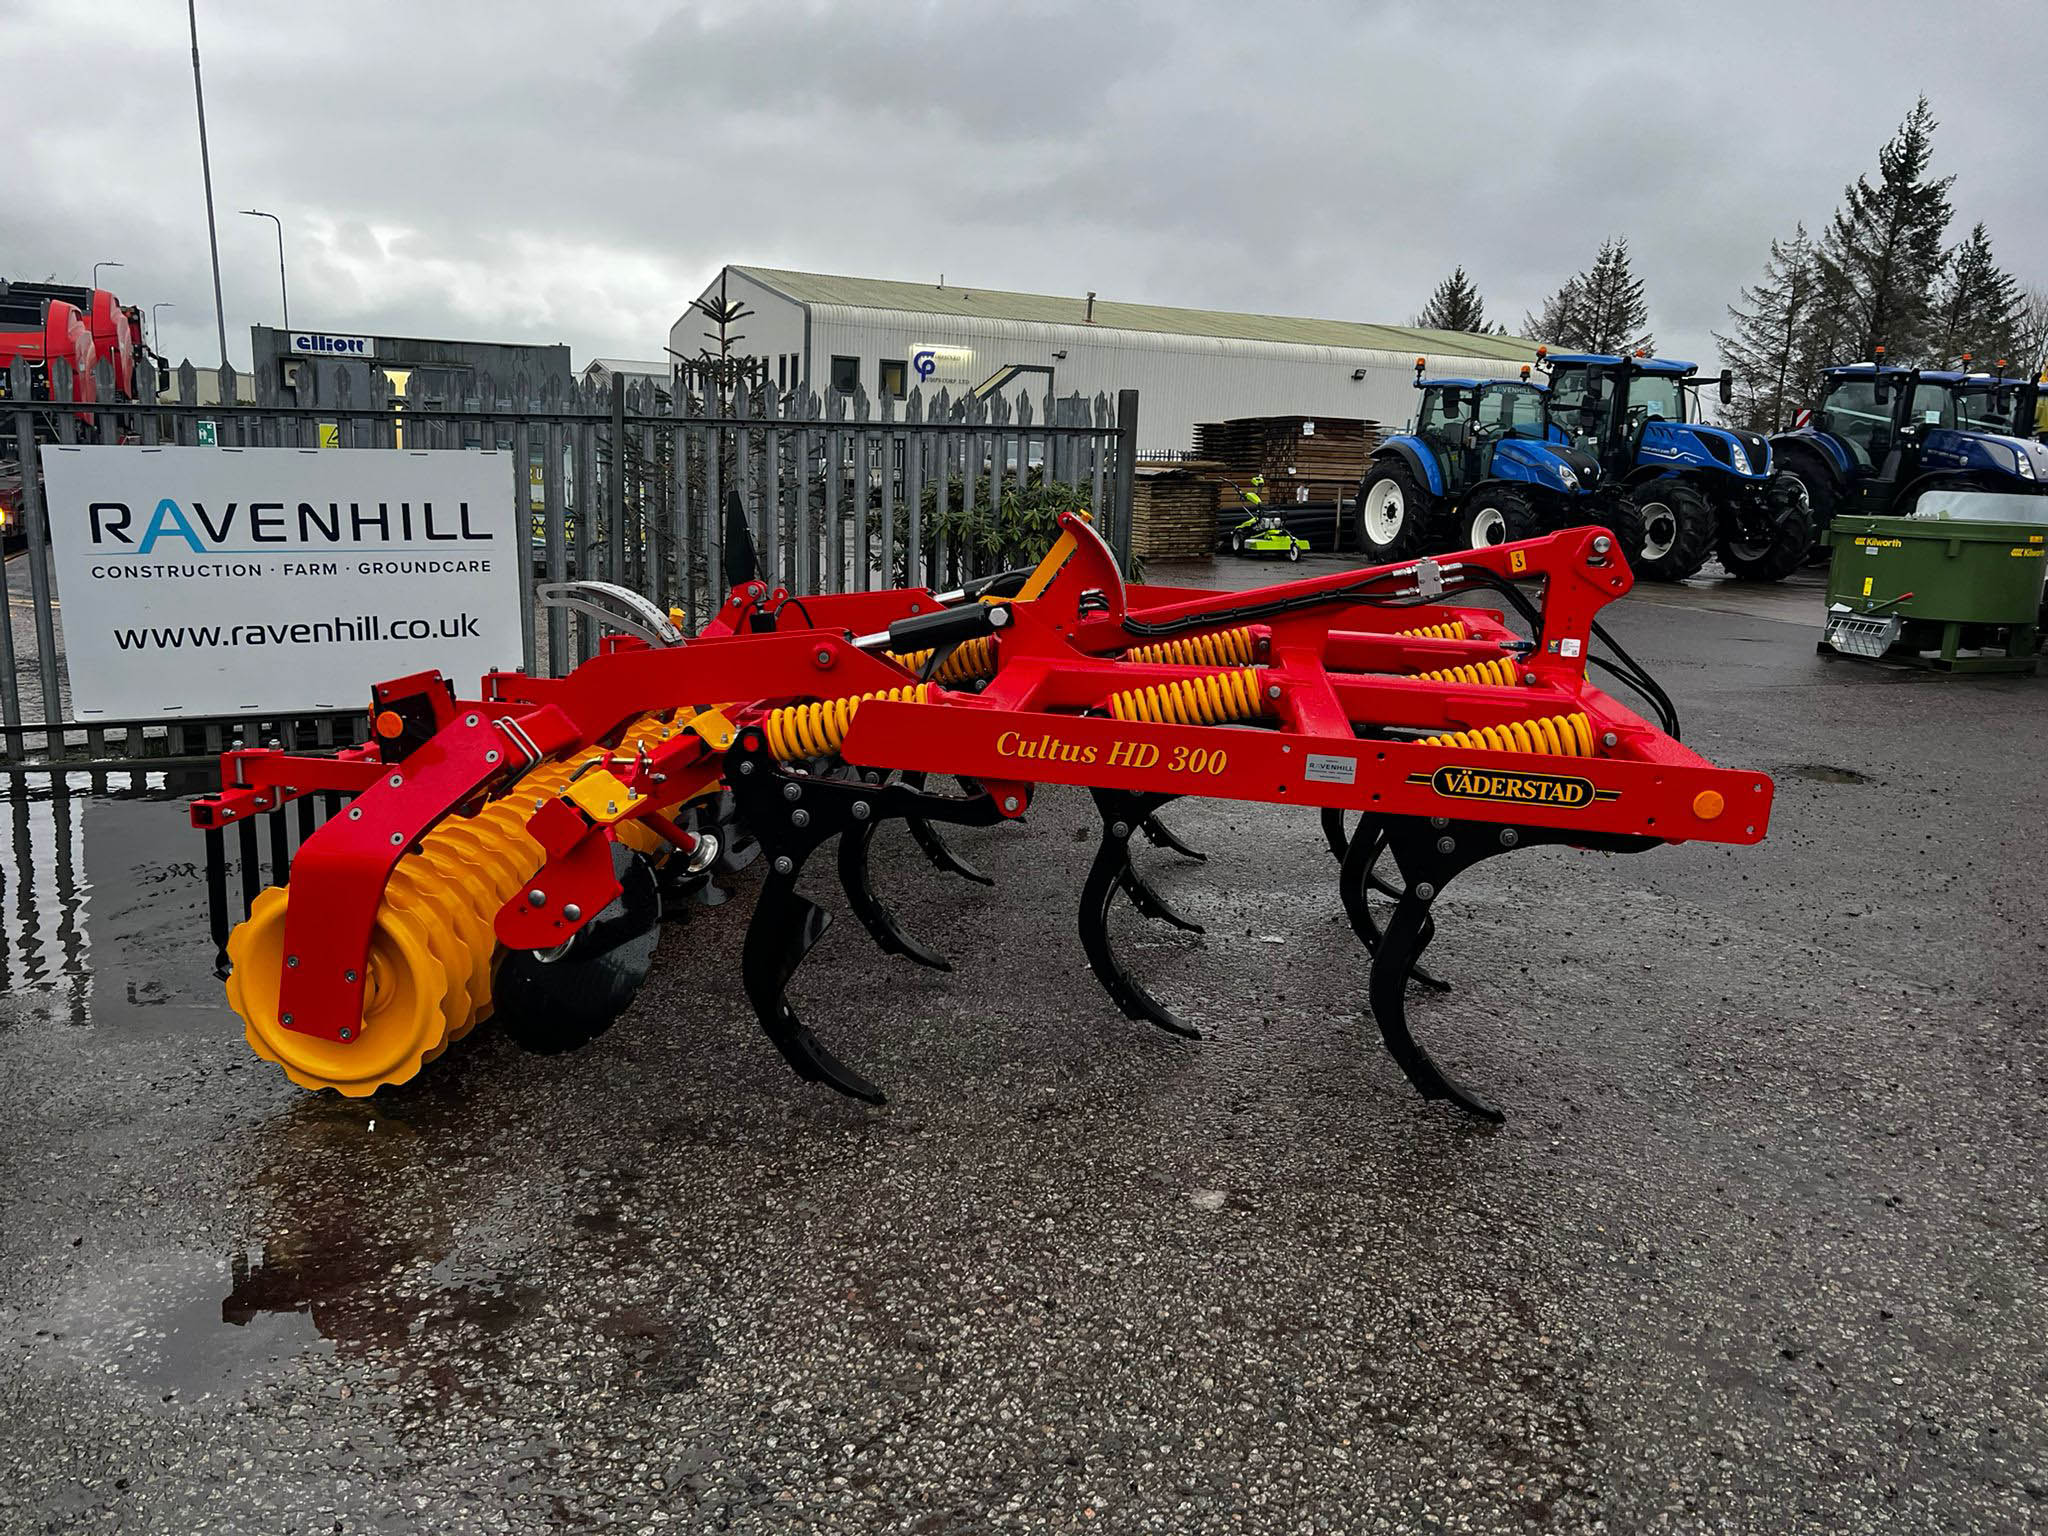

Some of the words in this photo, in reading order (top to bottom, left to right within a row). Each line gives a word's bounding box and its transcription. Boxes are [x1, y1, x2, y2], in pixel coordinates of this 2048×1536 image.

[297, 336, 364, 353] elliott
[88, 498, 493, 554] RAVENHILL
[1867, 537, 1902, 548] Kilworth
[91, 564, 262, 579] CONSTRUCTION
[283, 563, 338, 576] FARM
[358, 560, 491, 575] GROUNDCARE
[114, 613, 480, 650] www.ravenhill.co.uk
[996, 731, 1098, 764] Cultus
[1106, 741, 1160, 768] HD
[1167, 746, 1227, 775] 300
[1444, 769, 1583, 803] VÄDERSTAD
